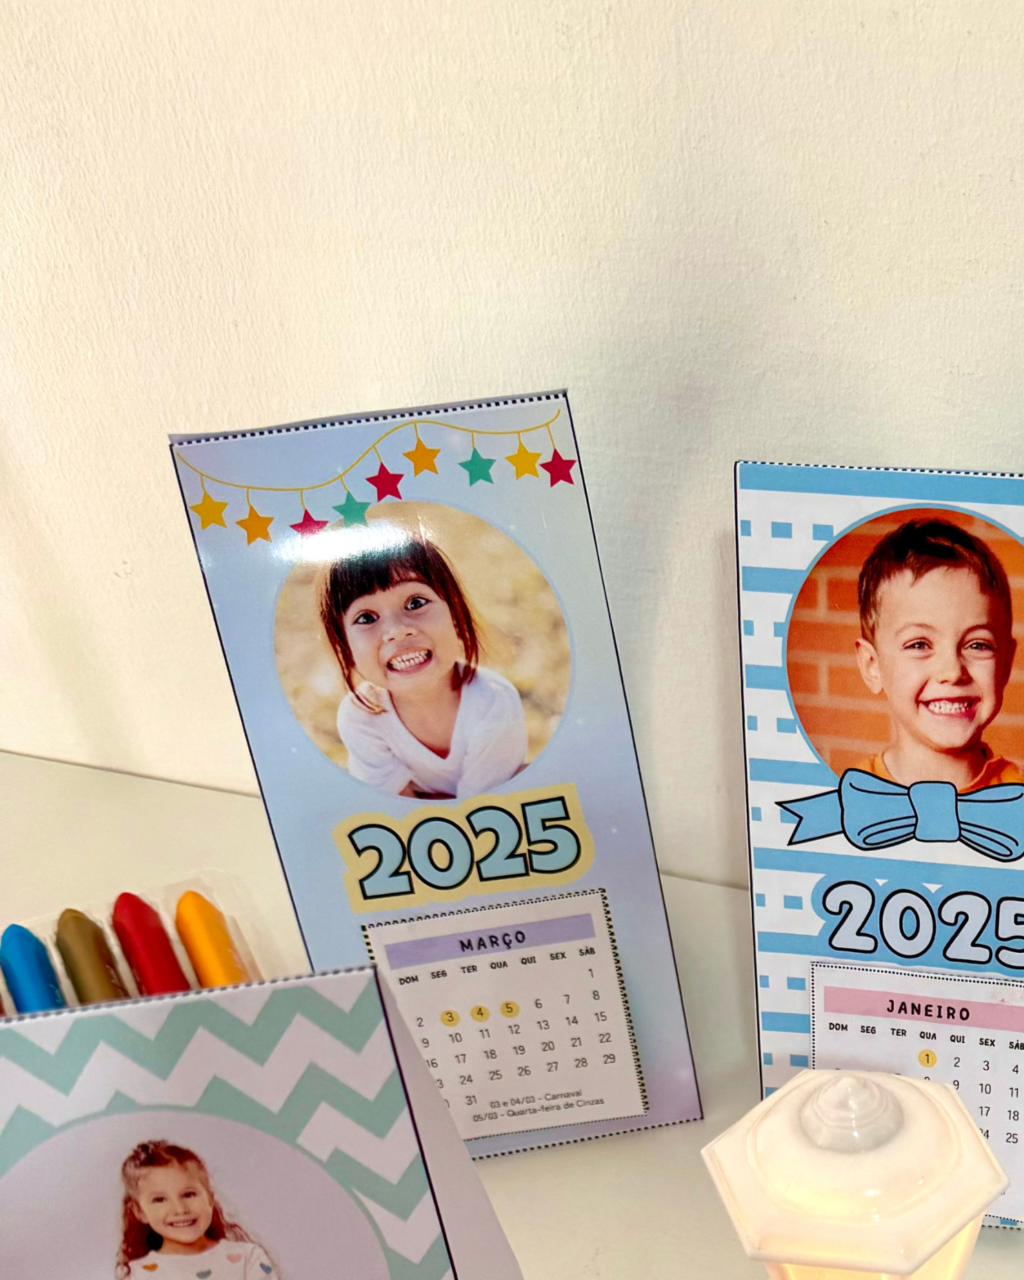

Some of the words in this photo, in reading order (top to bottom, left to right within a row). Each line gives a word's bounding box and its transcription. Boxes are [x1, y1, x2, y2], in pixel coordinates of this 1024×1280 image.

[348, 796, 581, 900] 2025
[459, 930, 527, 952] MARÇO
[397, 975, 419, 986] DOM
[430, 970, 448, 979] SEG
[460, 964, 478, 974] TER
[488, 960, 508, 970] QUA
[520, 956, 537, 965] QUI
[549, 952, 567, 961] SEX
[578, 946, 596, 956] SÁB
[588, 968, 594, 978] 1
[416, 1017, 424, 1028] 2
[447, 1012, 454, 1022] 3
[477, 1008, 483, 1017] 4
[506, 1004, 513, 1013] 5
[534, 998, 542, 1009] 6
[563, 994, 570, 1004] 7
[592, 990, 600, 1000] 8
[887, 999, 971, 1021] JANEIRO
[828, 1022, 848, 1032] DOM
[860, 1025, 876, 1034] SEG
[890, 1028, 907, 1037] TER
[919, 1031, 937, 1040] QUA
[950, 1034, 965, 1044] QUI
[979, 1038, 996, 1047] SEX
[1008, 1040, 1024, 1050] SÁB
[925, 1054, 930, 1063] 1
[954, 1056, 960, 1068] 2
[982, 1060, 990, 1071] 3
[1012, 1064, 1019, 1074] 4
[490, 1101, 500, 1109] 03
[544, 1089, 583, 1102] Carnaval
[953, 1080, 959, 1090] 9
[979, 1083, 992, 1094] 10
[1009, 1087, 1019, 1098] 11
[473, 1112, 498, 1122] 05/03
[507, 1104, 561, 1118] Quarta-feira
[564, 1102, 574, 1110] de
[576, 1098, 605, 1108] Cinzas
[978, 1106, 990, 1117] 17
[1007, 1110, 1020, 1121] 18
[979, 1129, 989, 1140] 4
[1006, 1132, 1018, 1144] 25
